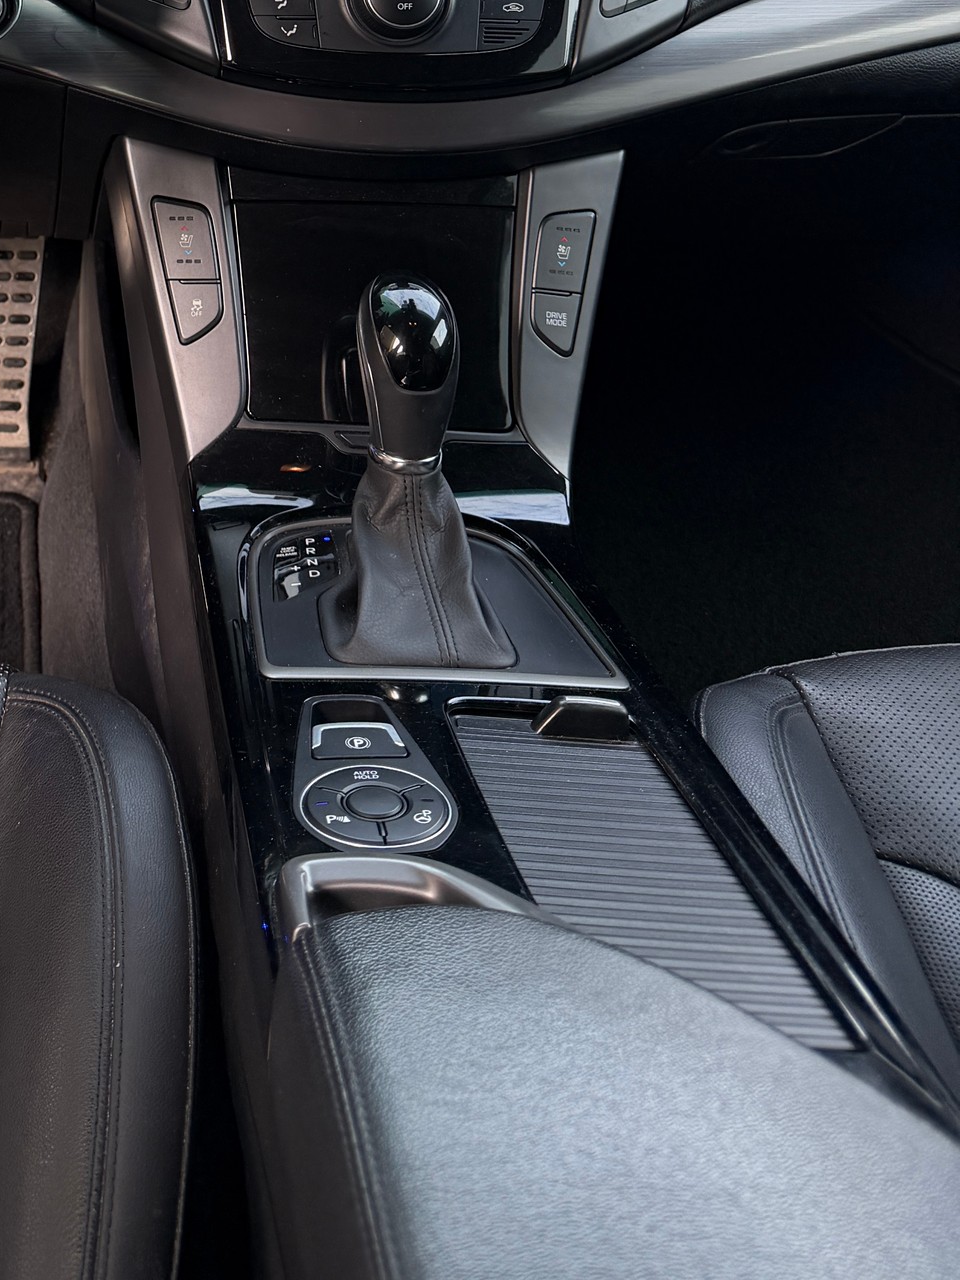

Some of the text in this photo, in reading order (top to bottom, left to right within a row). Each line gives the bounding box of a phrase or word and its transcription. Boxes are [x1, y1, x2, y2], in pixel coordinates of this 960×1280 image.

[397, 2, 413, 11] OFF
[546, 311, 567, 319] DRIVE
[546, 318, 567, 327] MODE
[305, 537, 316, 546] P
[305, 547, 316, 555] R
[307, 558, 318, 566] N
[309, 569, 321, 578] D
